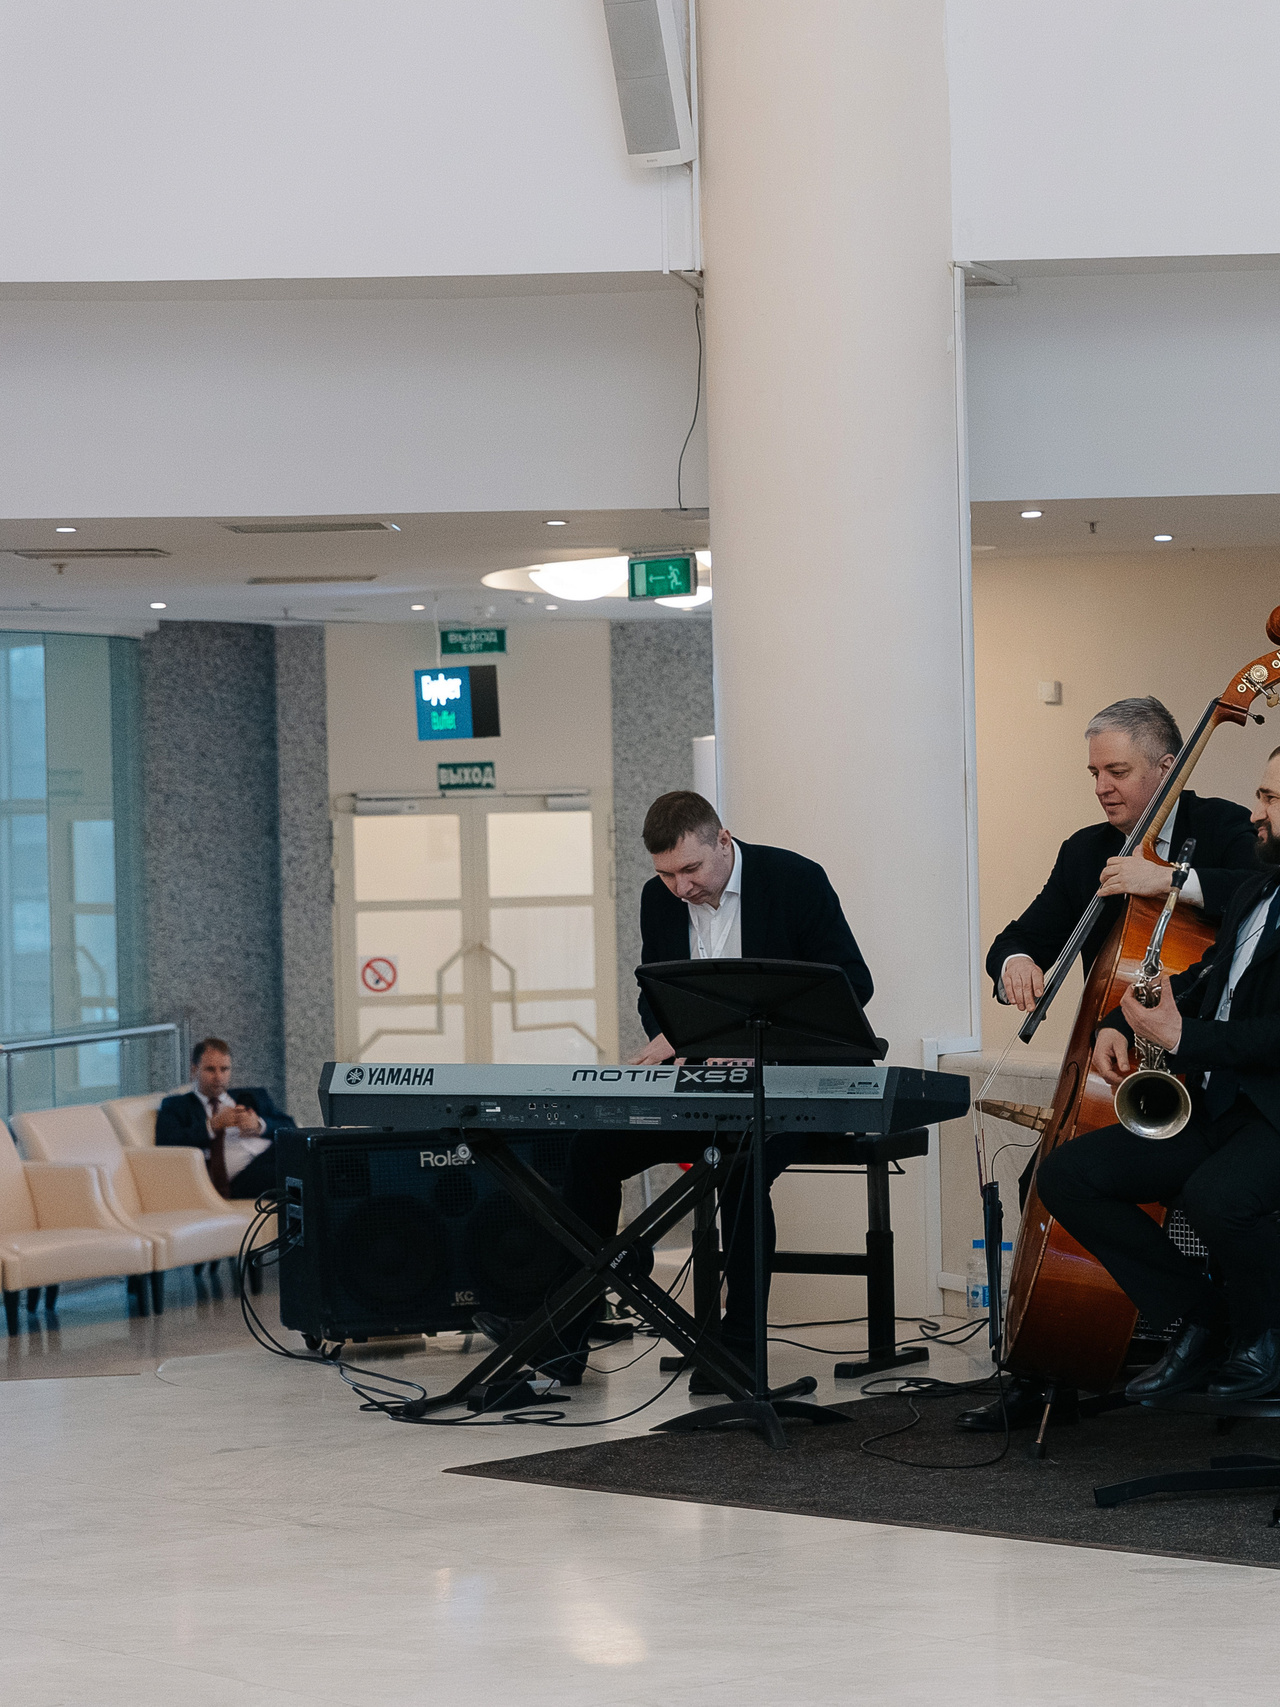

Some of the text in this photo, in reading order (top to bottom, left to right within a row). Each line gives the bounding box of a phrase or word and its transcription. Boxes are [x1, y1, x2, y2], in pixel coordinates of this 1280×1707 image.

[440, 766, 495, 787] ВЫХОД
[368, 1068, 434, 1085] YAMAHA
[679, 1068, 748, 1083] XS8
[455, 1291, 474, 1302] KC
